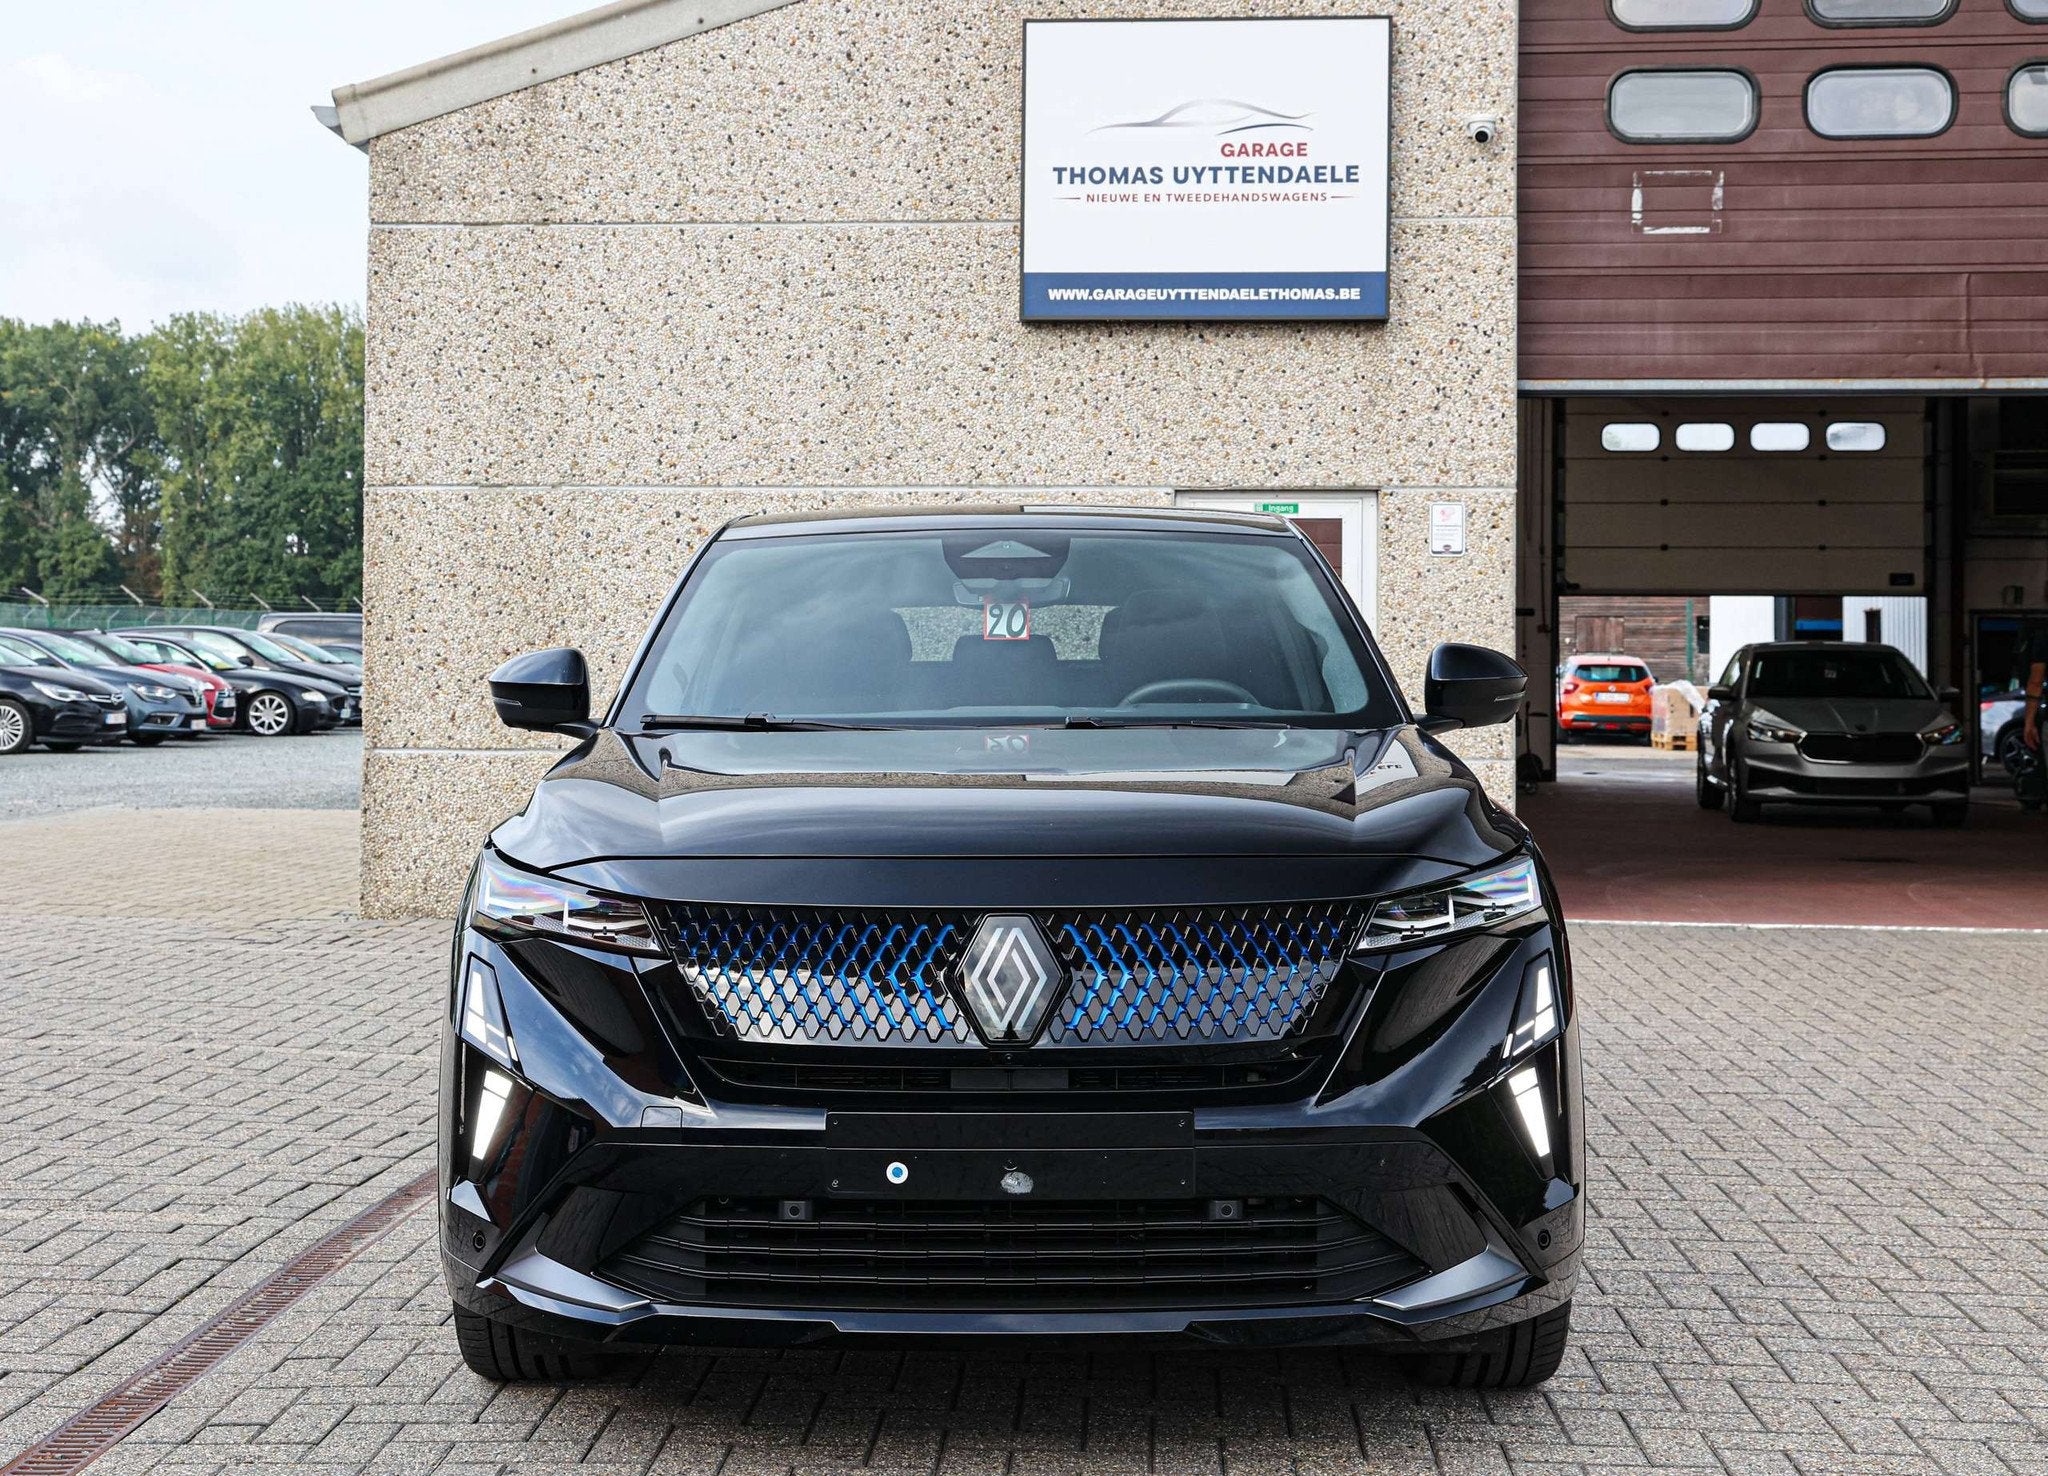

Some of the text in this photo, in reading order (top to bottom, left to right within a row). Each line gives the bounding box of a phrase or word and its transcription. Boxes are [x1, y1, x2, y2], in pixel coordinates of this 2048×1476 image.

[1220, 142, 1308, 157] GARAGE
[1052, 165, 1360, 185] THOMAS UYTTENDAELE
[1086, 192, 1327, 203] NIEUWE EN TWEEDEHANDSWAGENS
[1048, 287, 1361, 301] WWW.GARAGEUYTTENDAELETHOMAS.BE
[1268, 504, 1294, 514] Ingang
